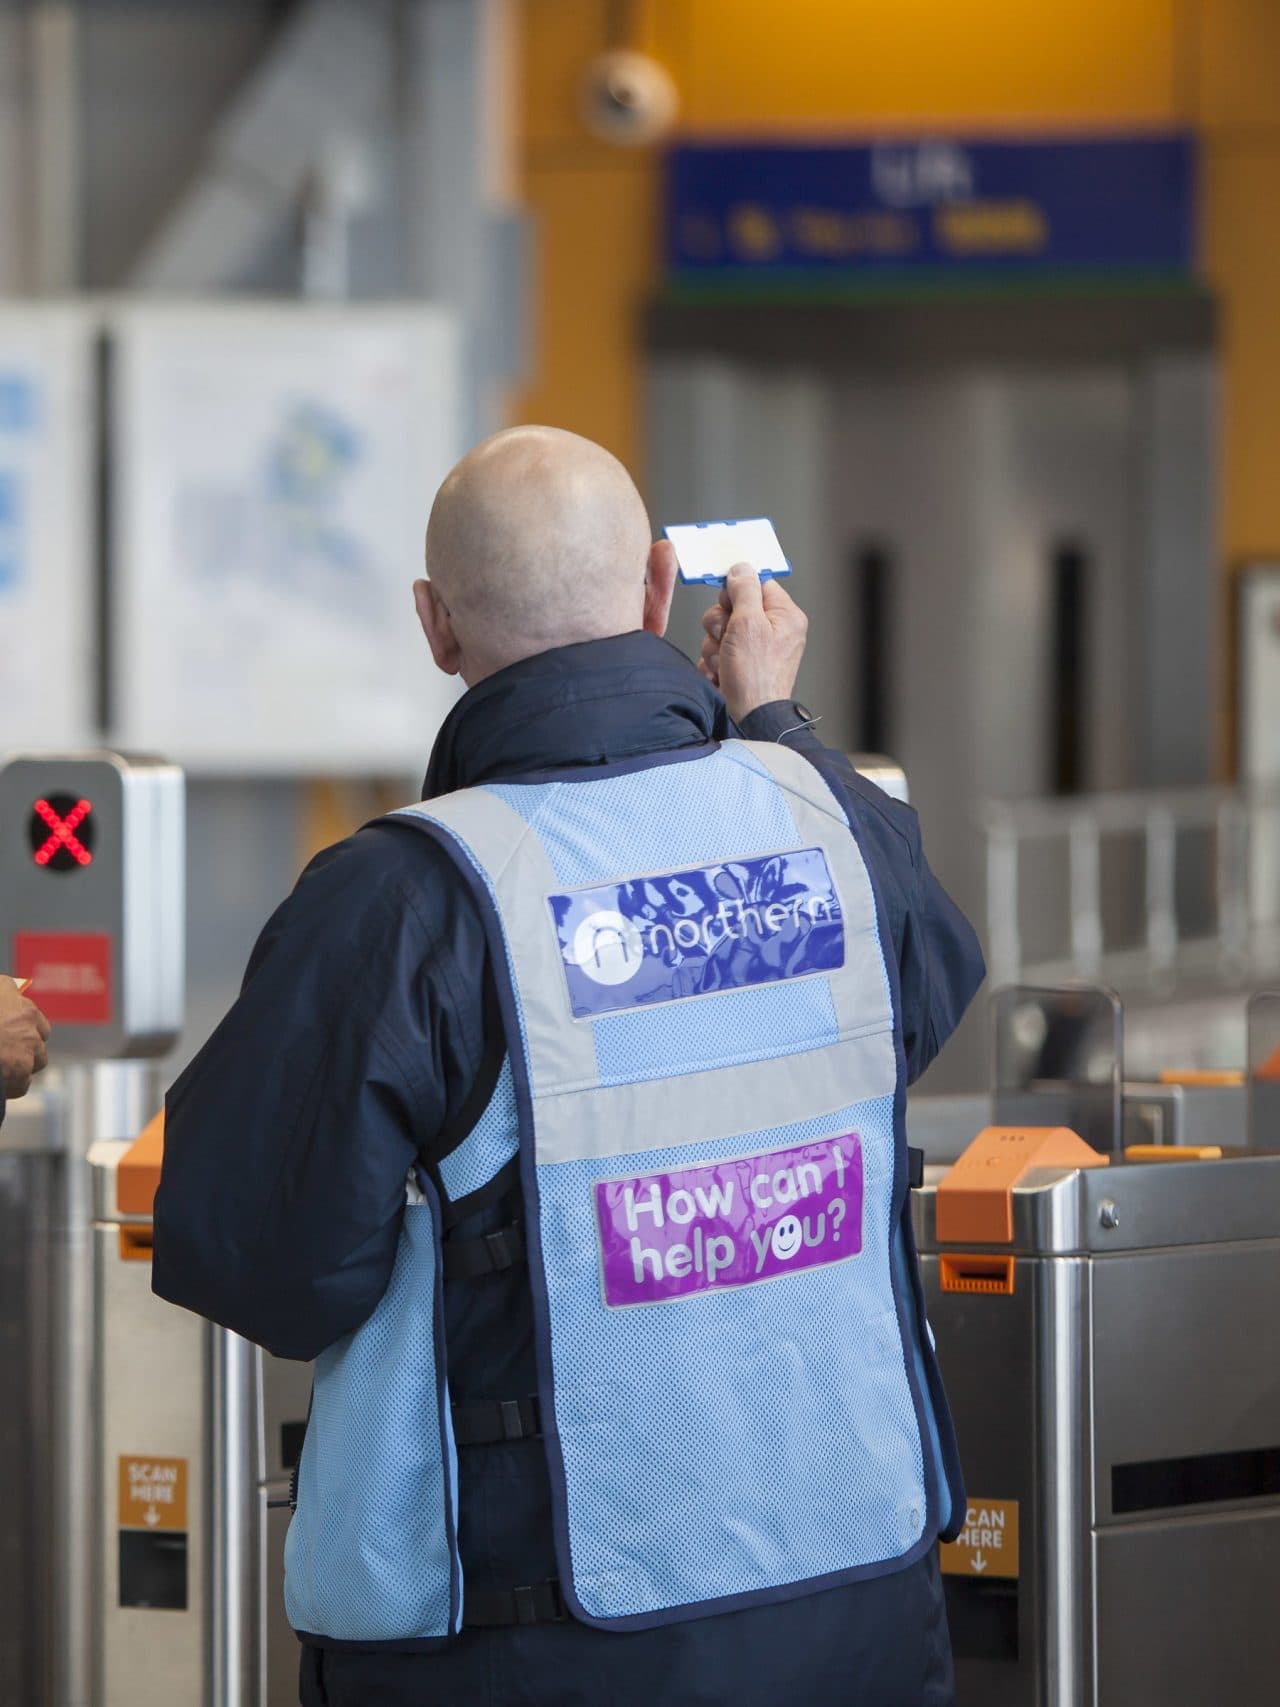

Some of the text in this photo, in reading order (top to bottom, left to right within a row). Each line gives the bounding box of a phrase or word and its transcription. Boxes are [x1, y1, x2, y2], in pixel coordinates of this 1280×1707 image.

[648, 896, 834, 955] northern
[624, 1145, 846, 1232] How can I
[630, 1226, 735, 1283] help
[127, 1463, 177, 1484] SCAN
[130, 1484, 174, 1504] HERE
[966, 1507, 1005, 1529] CAN
[956, 1528, 1002, 1549] HERE
